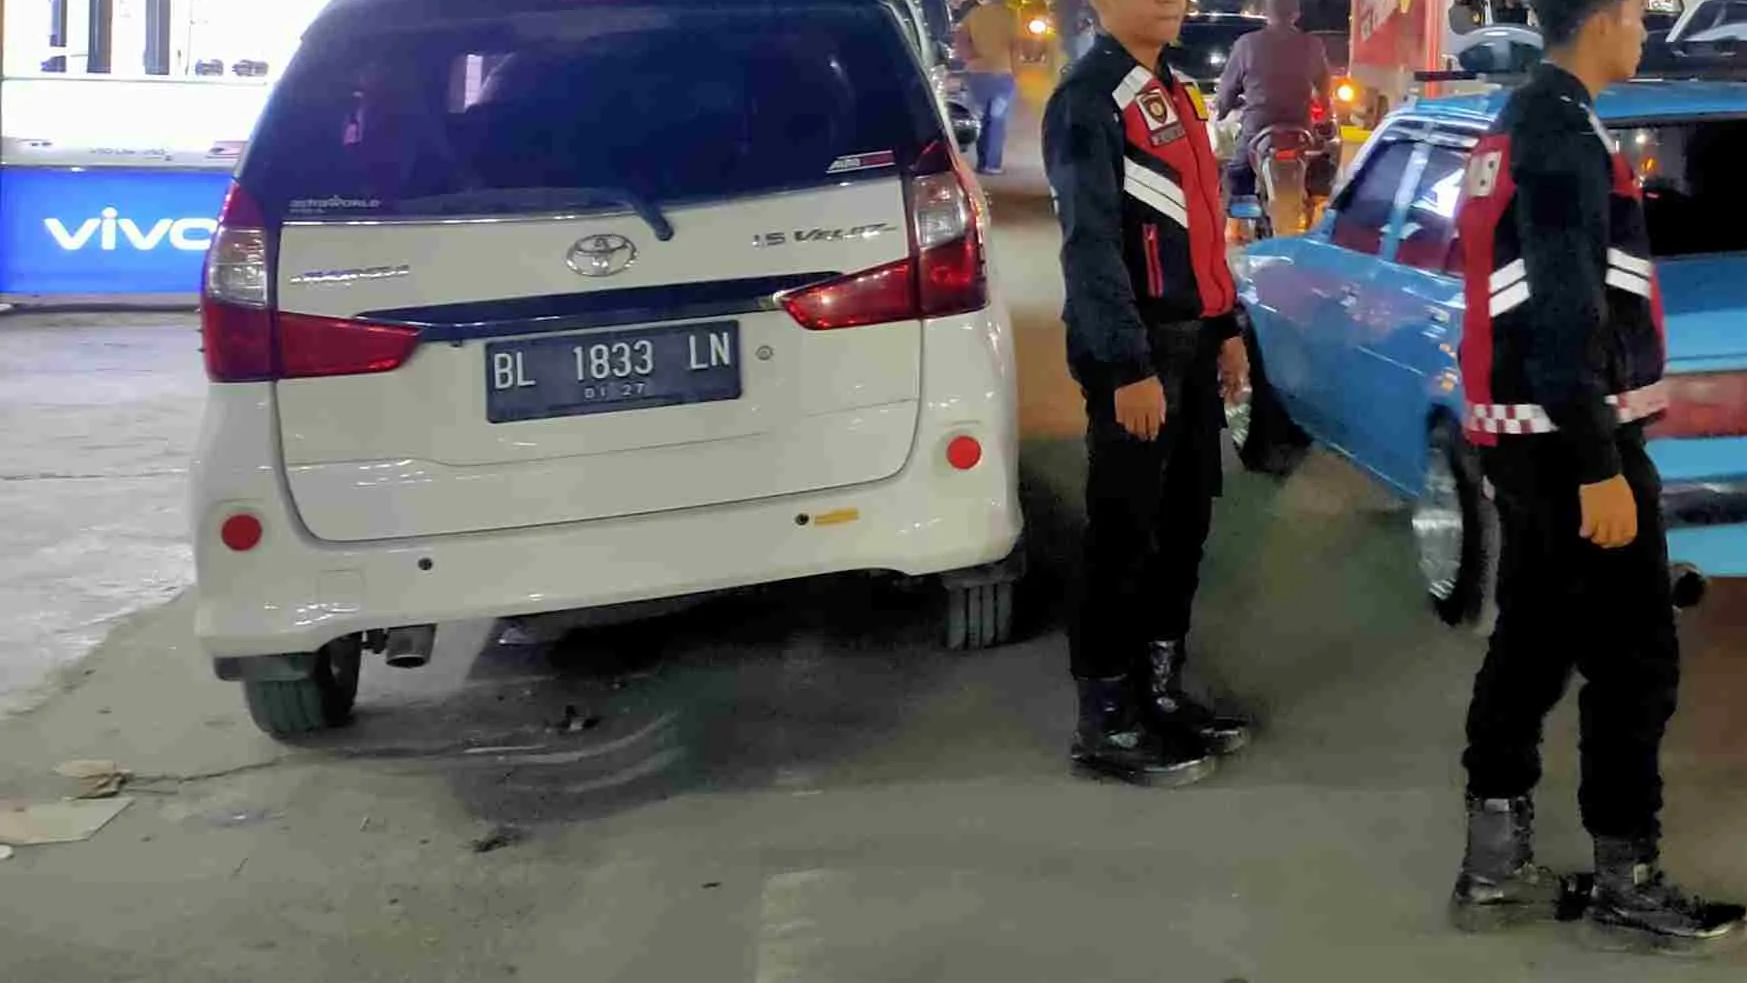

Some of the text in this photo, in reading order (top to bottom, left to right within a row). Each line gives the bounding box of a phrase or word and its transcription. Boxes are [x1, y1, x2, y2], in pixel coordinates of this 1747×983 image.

[44, 206, 219, 251] vivo
[493, 332, 731, 390] BL 1833 LN
